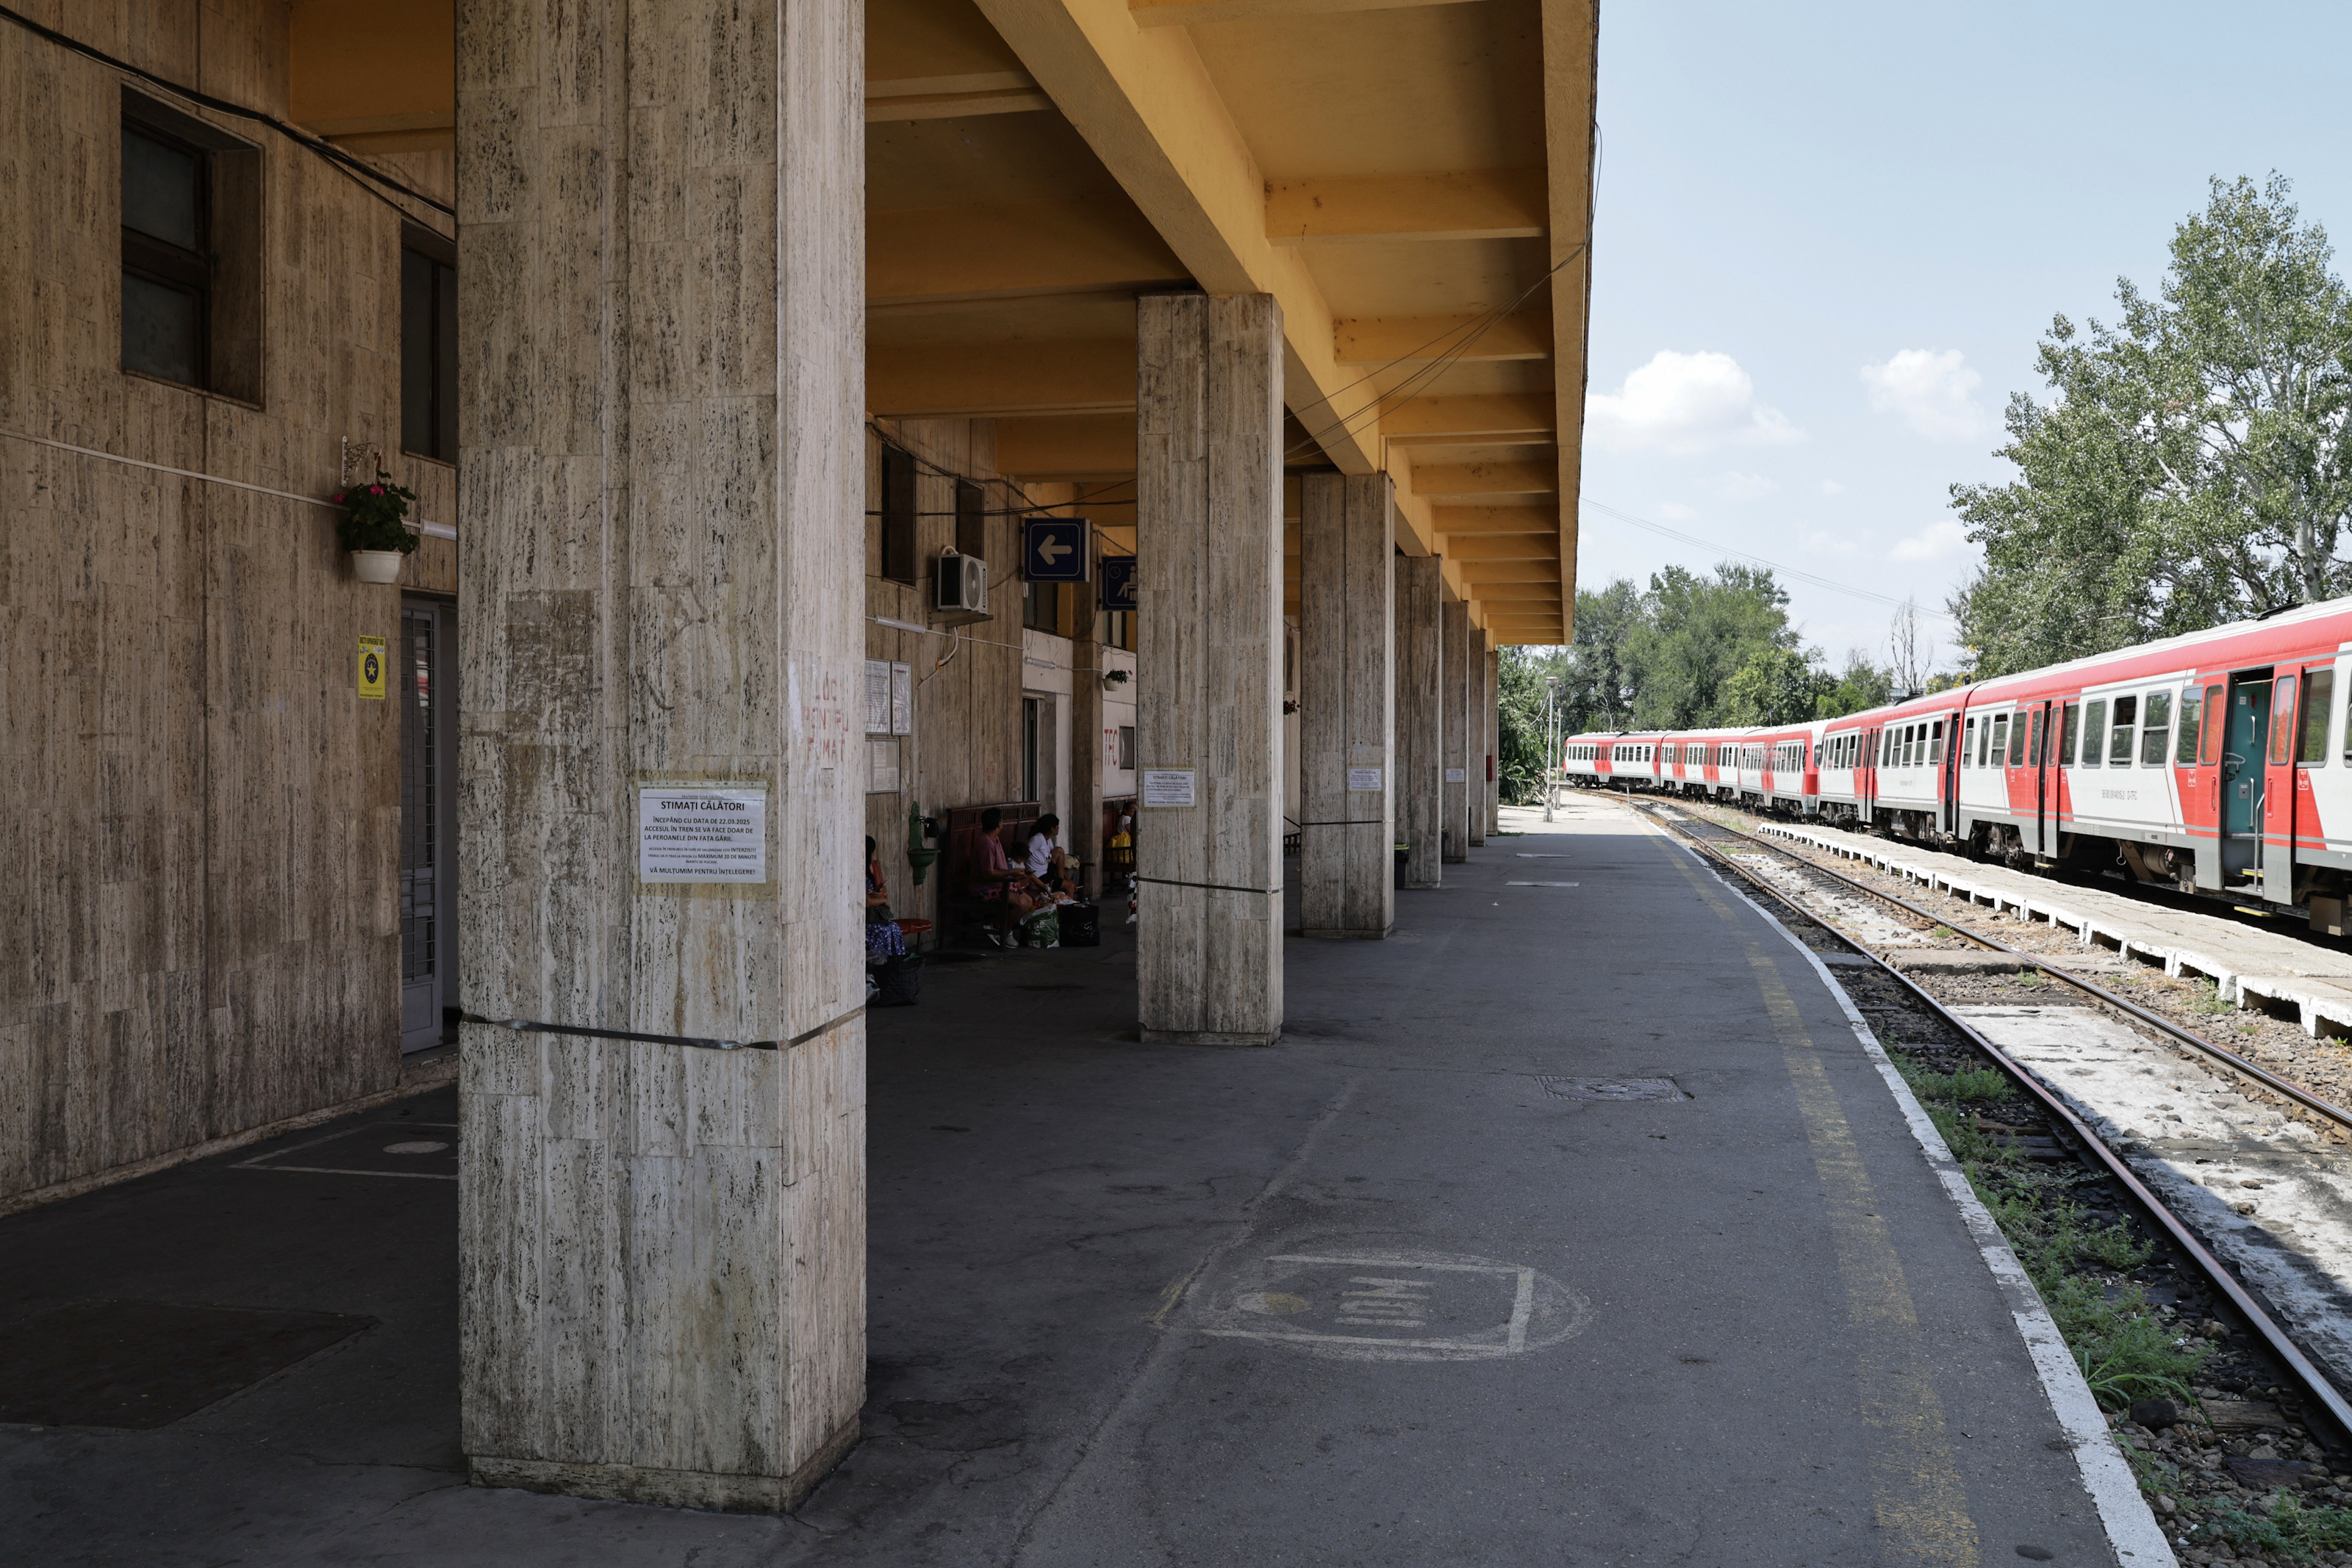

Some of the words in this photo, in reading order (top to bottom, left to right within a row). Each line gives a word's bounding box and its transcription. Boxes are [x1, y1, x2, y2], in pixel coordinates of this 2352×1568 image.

[815, 677, 837, 702] LOC
[803, 706, 849, 732] PENTRU
[808, 738, 845, 762] FUMAT
[1104, 728, 1118, 766] TFC
[661, 801, 698, 812] STIMAȚI
[700, 800, 745, 811] CĂLĂTORI
[653, 816, 683, 824] ÎNCEPÂND
